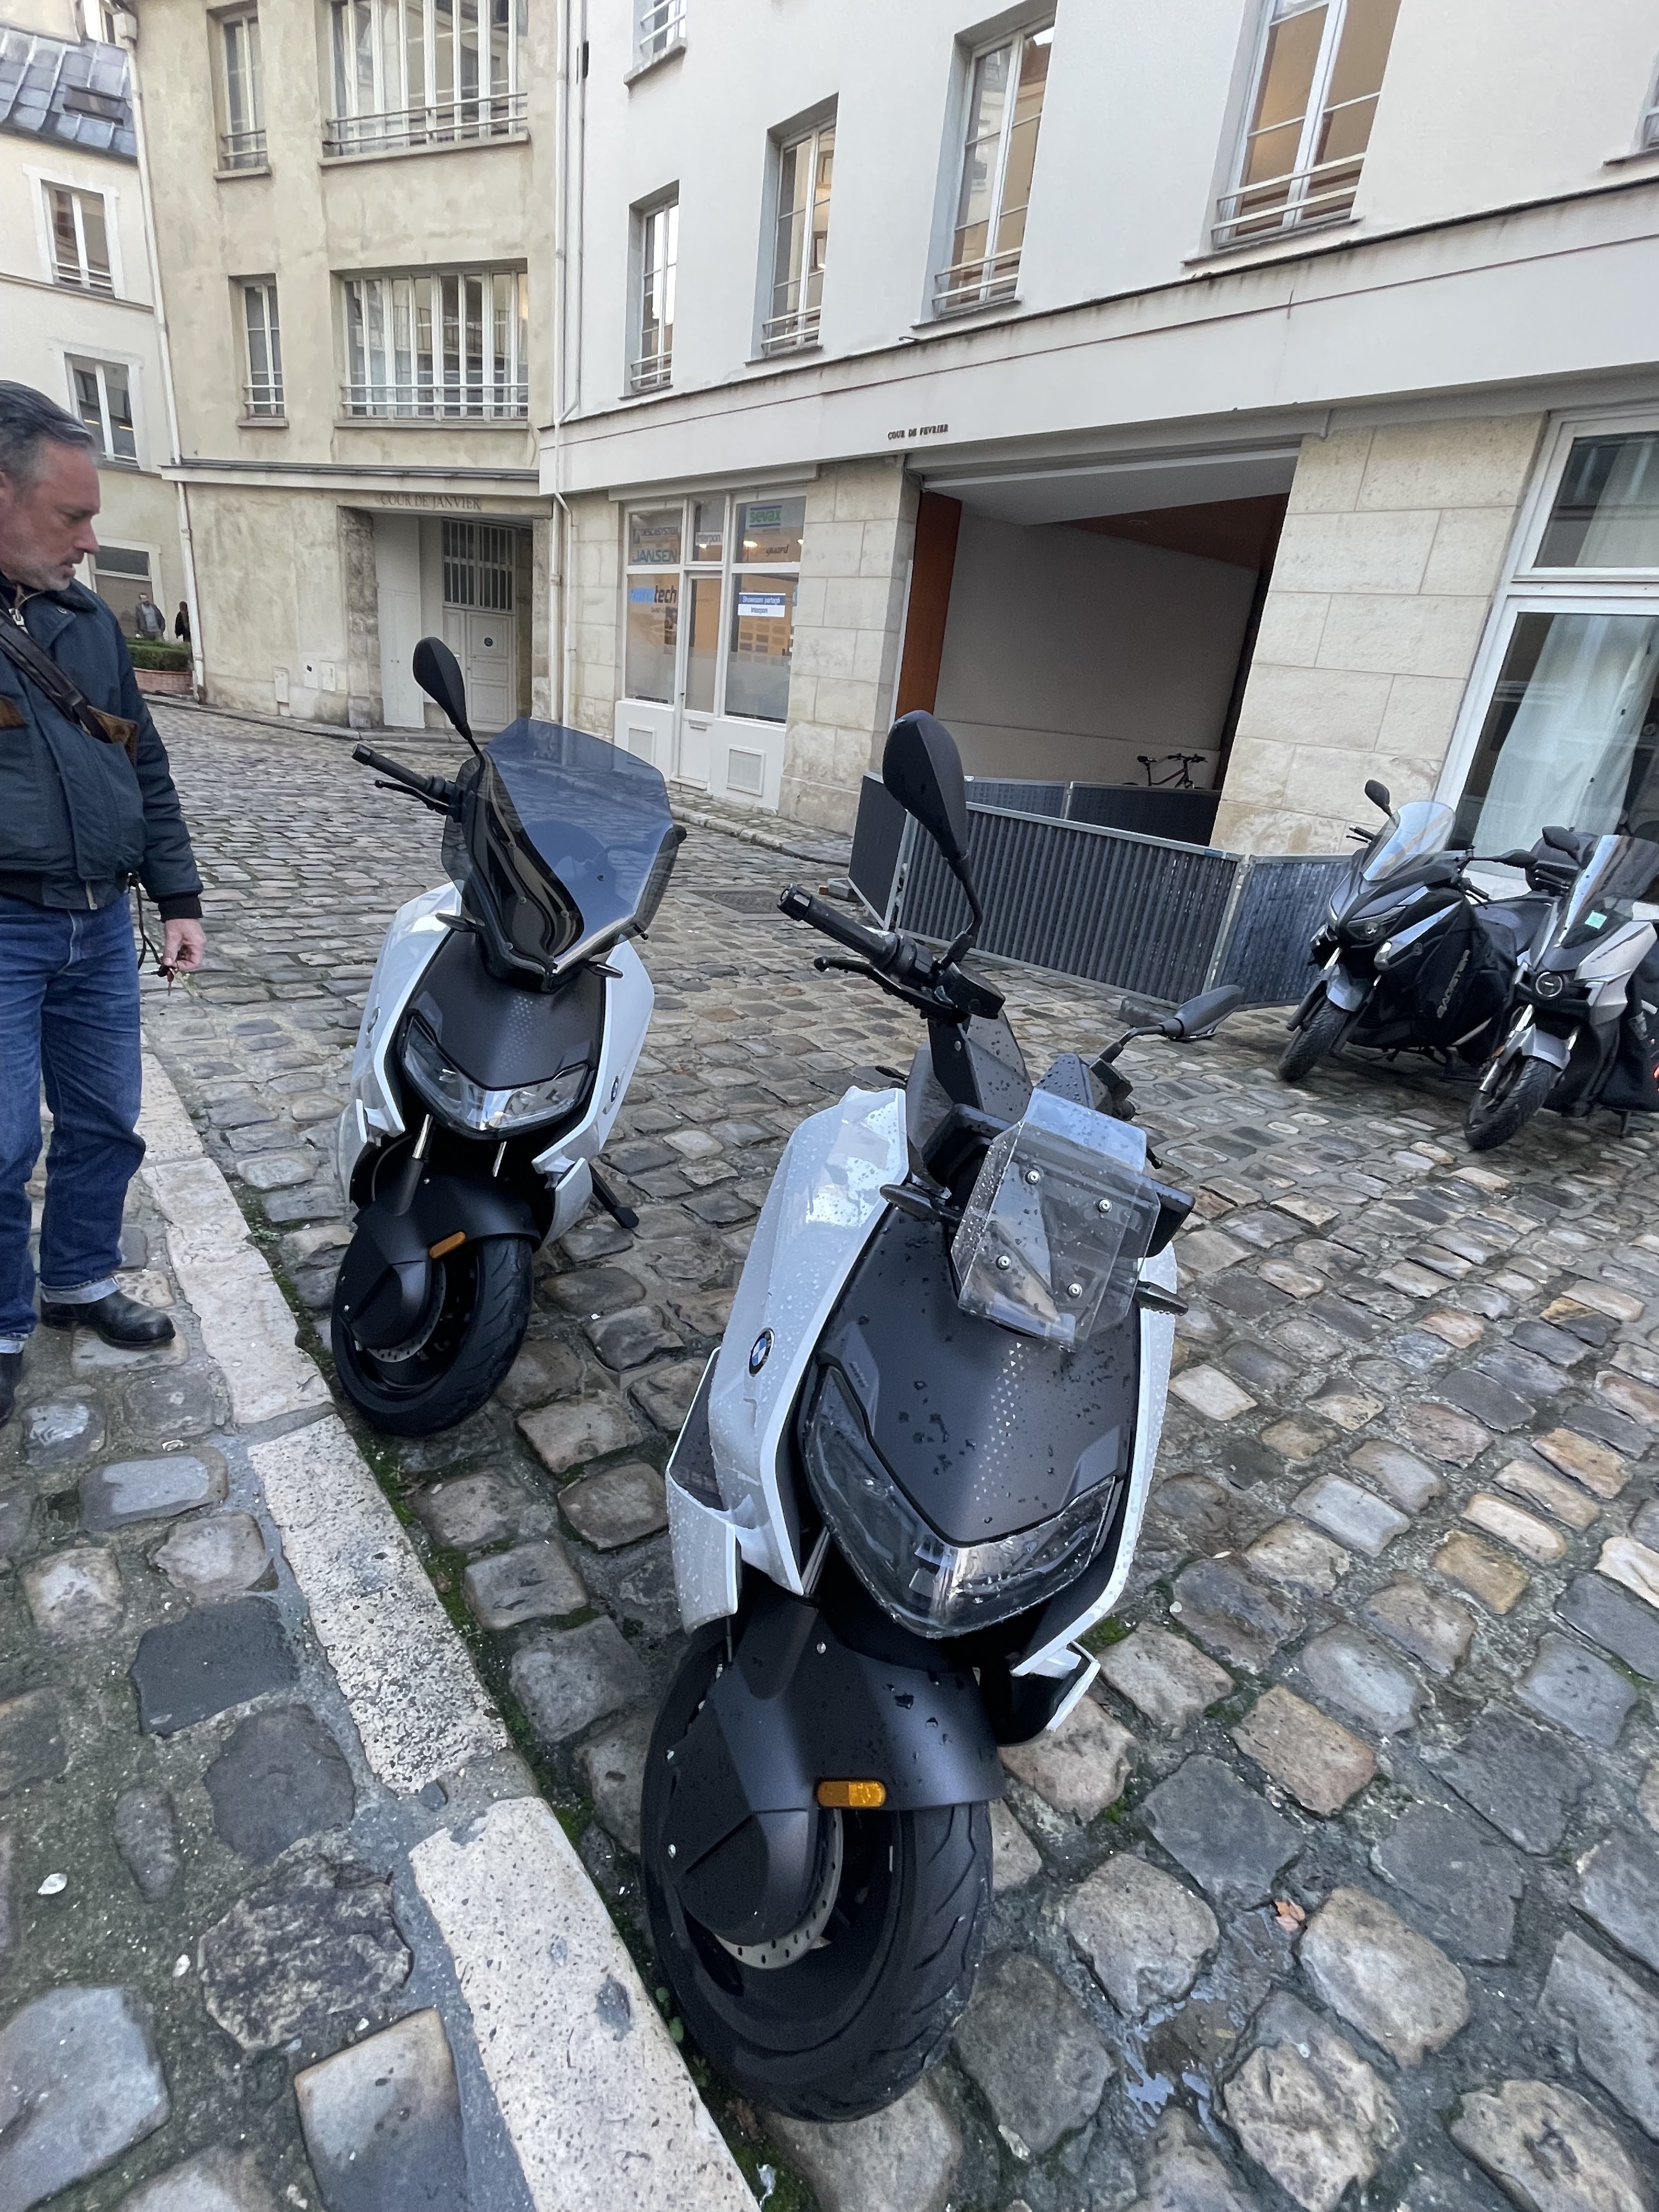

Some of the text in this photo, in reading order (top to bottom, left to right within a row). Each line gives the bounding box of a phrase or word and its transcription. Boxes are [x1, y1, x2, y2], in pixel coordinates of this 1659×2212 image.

[888, 430, 905, 439] COUR
[909, 428, 917, 437] DE
[380, 493, 482, 511] COUR DE JANVIER
[749, 509, 781, 523] sevax
[632, 549, 678, 562] JANSEN
